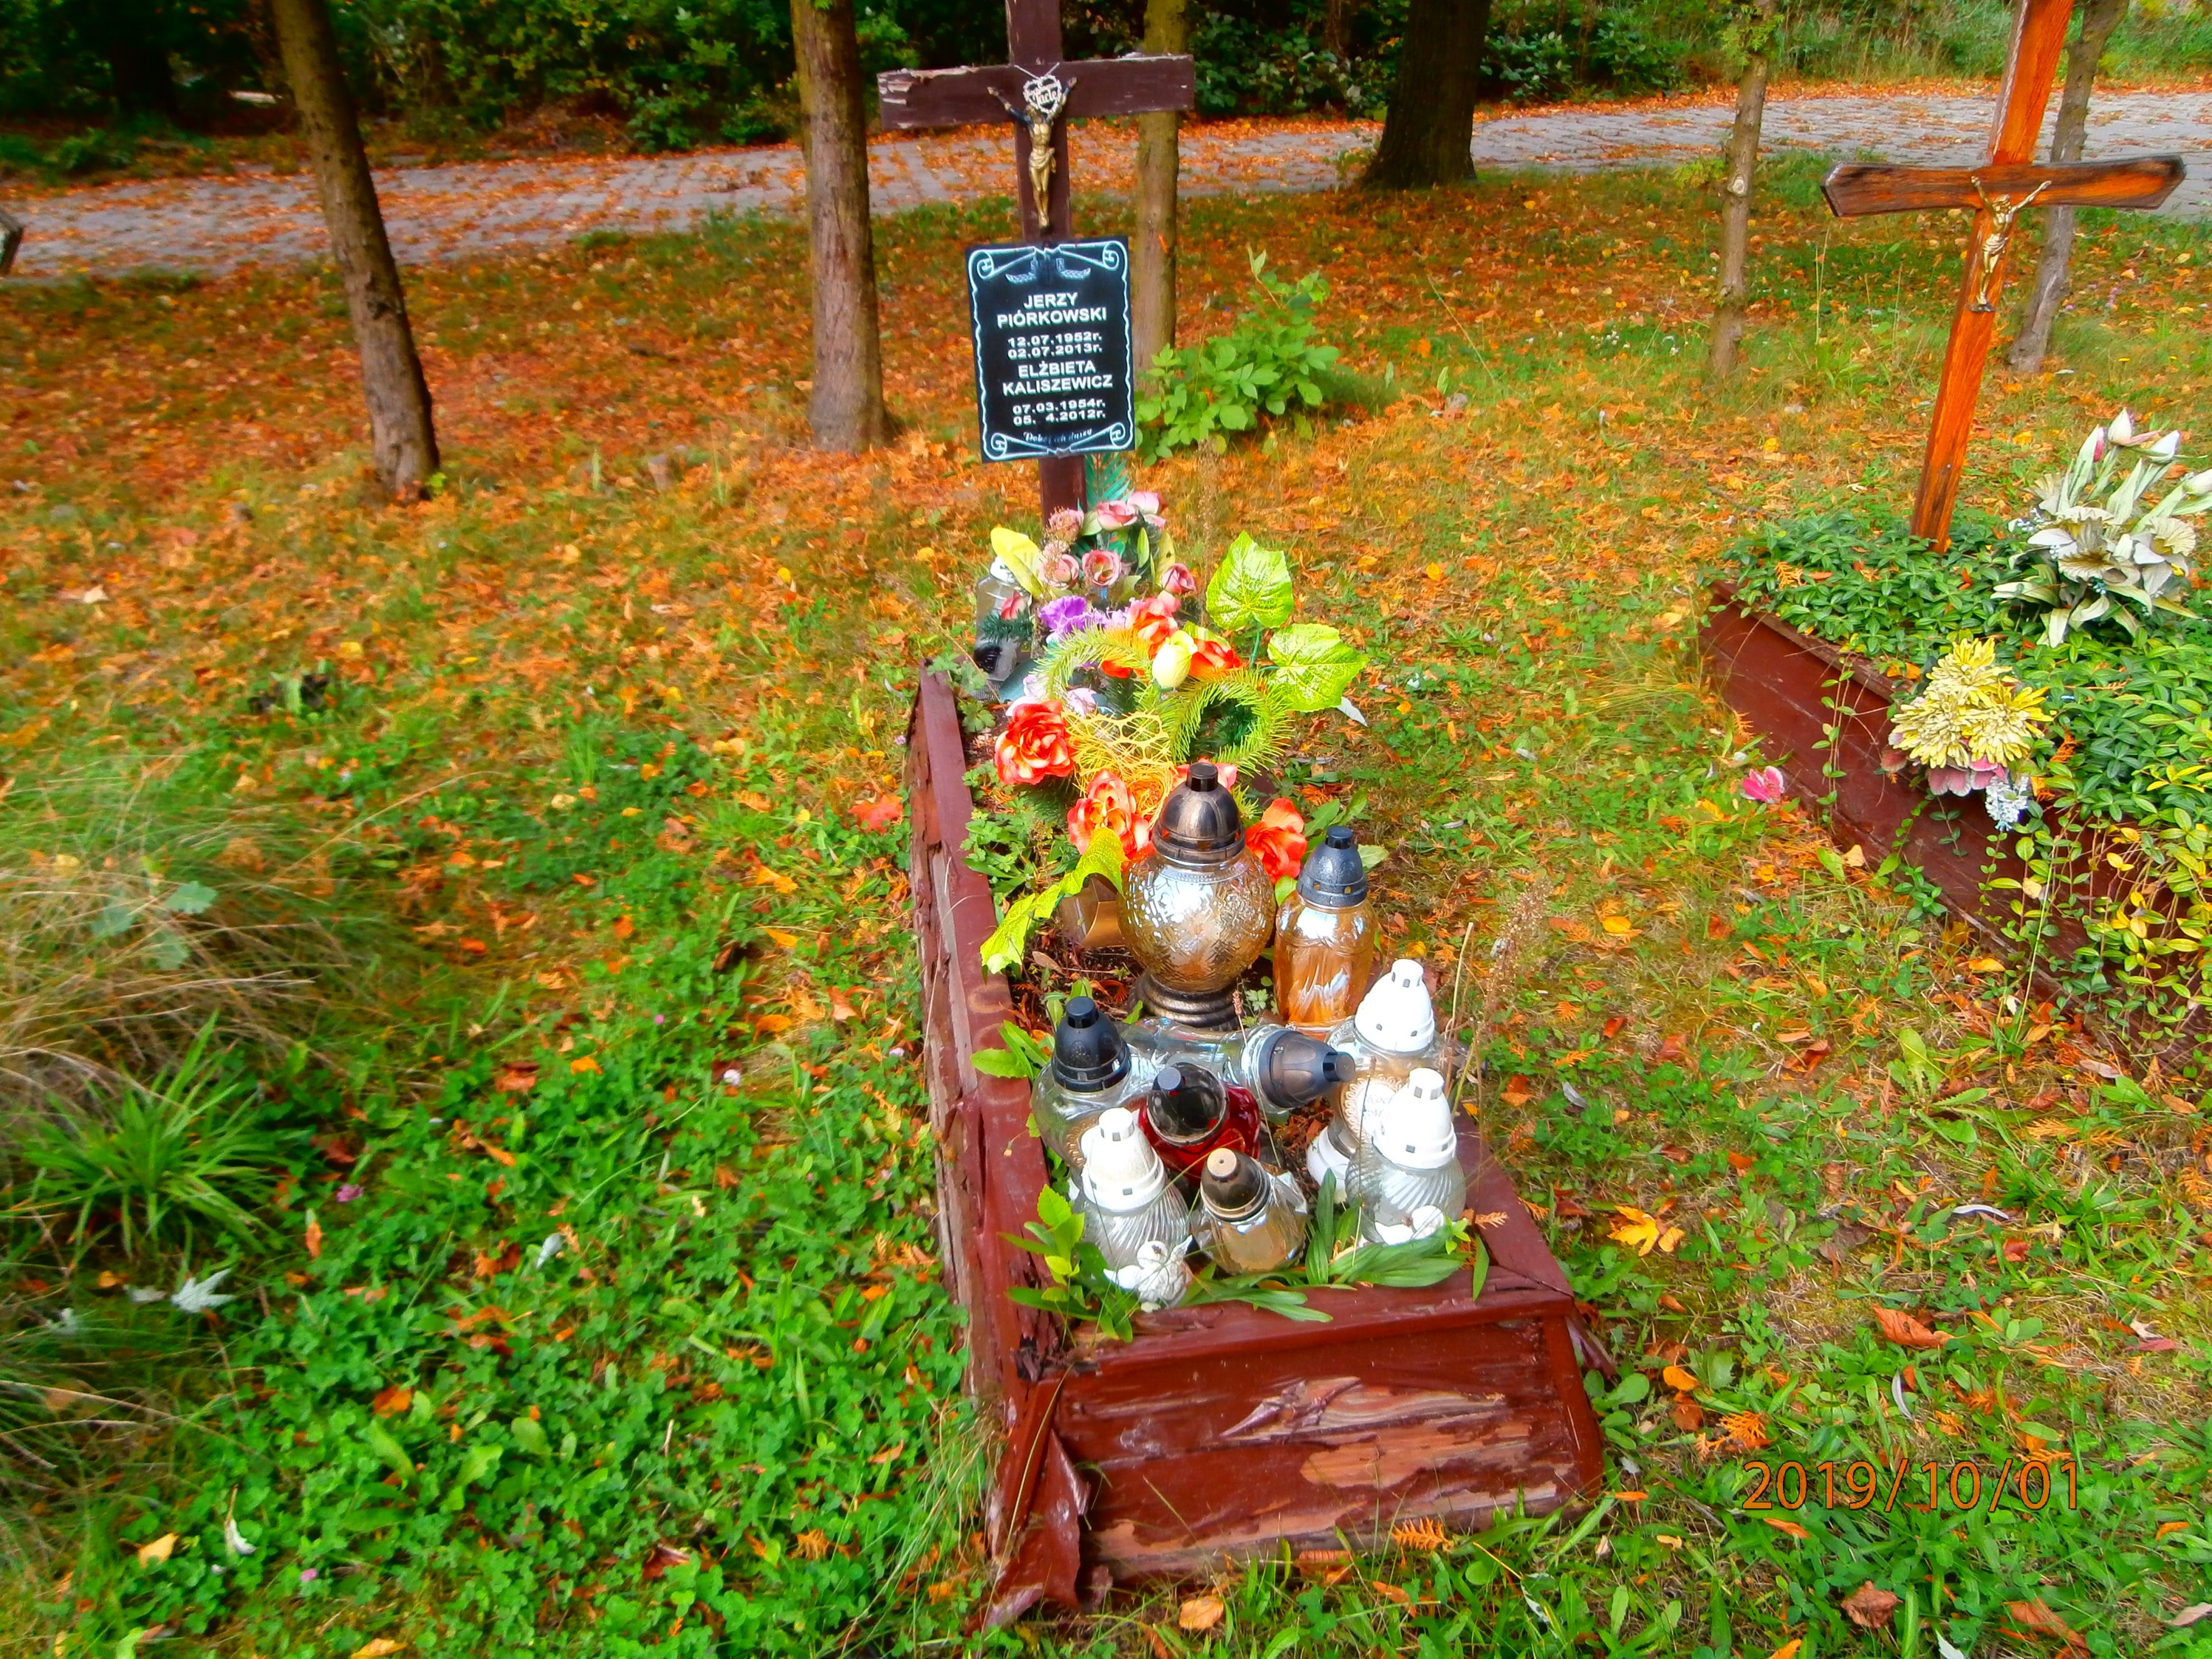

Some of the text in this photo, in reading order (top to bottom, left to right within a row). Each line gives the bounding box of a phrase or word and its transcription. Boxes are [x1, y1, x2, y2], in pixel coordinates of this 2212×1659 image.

[1023, 293, 1078, 309] JERZY
[997, 307, 1106, 329] PIÓRKOWSKI
[1008, 332, 1102, 347] 12.07.1952r.
[1008, 343, 1102, 360] 02.07.2013r.
[1018, 360, 1095, 378] ELŻBIETA
[1002, 374, 1112, 396] KALISZEWICZ
[1013, 398, 1106, 415] 07.03.1954r.
